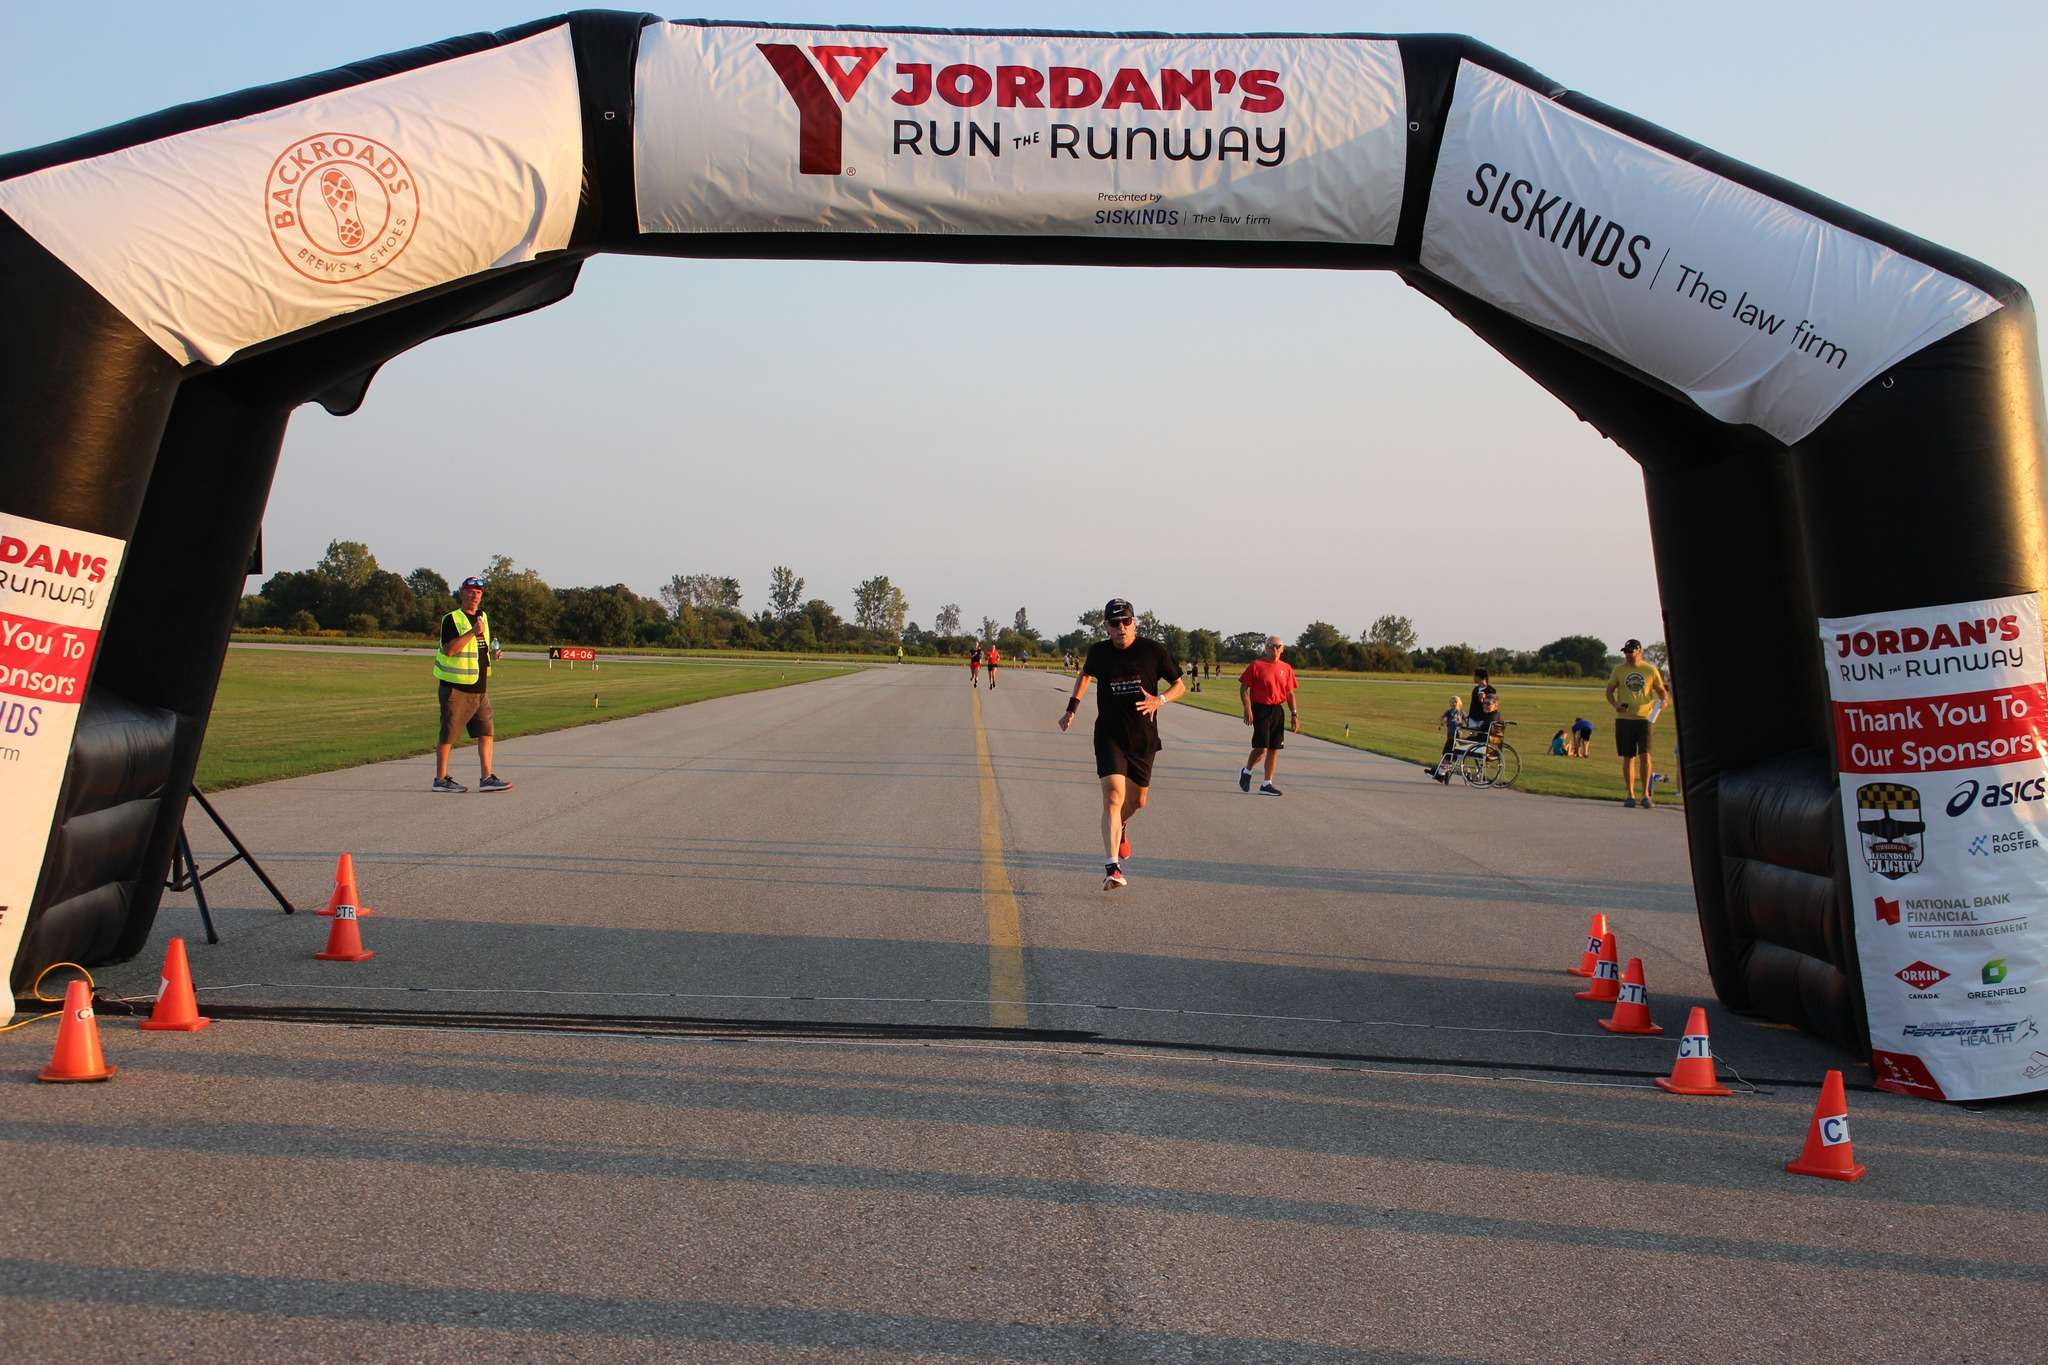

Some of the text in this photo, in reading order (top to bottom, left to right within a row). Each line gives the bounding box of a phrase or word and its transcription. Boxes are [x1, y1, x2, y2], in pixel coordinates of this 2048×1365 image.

[891, 63, 1284, 113] JORDAN'S
[893, 119, 1001, 156] RUN
[1013, 131, 1040, 149] THE
[272, 138, 409, 229] BACKROADS
[1098, 192, 1162, 203] Presented by
[1095, 209, 1271, 225] SISKINDS The law firm
[297, 248, 347, 273] BREWS
[370, 218, 407, 264] SHOES
[1467, 162, 1849, 370] SISKINDS The law firm
[2, 620, 85, 659] You To
[1836, 615, 2020, 659] JORDAN'S
[564, 650, 593, 659] 24-06
[1840, 662, 1884, 682] RUN
[1845, 694, 2028, 733] Thank You To
[1851, 733, 2032, 770] Our Sponsors
[1992, 831, 2024, 843] RACE
[1993, 840, 2039, 854] ROSTER
[1905, 893, 2011, 910] NATIONAL BANK
[1907, 911, 1979, 922] FINANCIAL
[1908, 922, 2029, 939] WEALTH MANAGEMENT
[1588, 937, 1602, 954] R
[1594, 961, 1619, 979] TR
[1902, 970, 1941, 981] ORKIN
[1968, 986, 2027, 1000] GREENFIELD
[1680, 1036, 1710, 1057] CT
[1961, 1032, 2012, 1047] HEALTH
[1824, 1117, 1847, 1142] C
